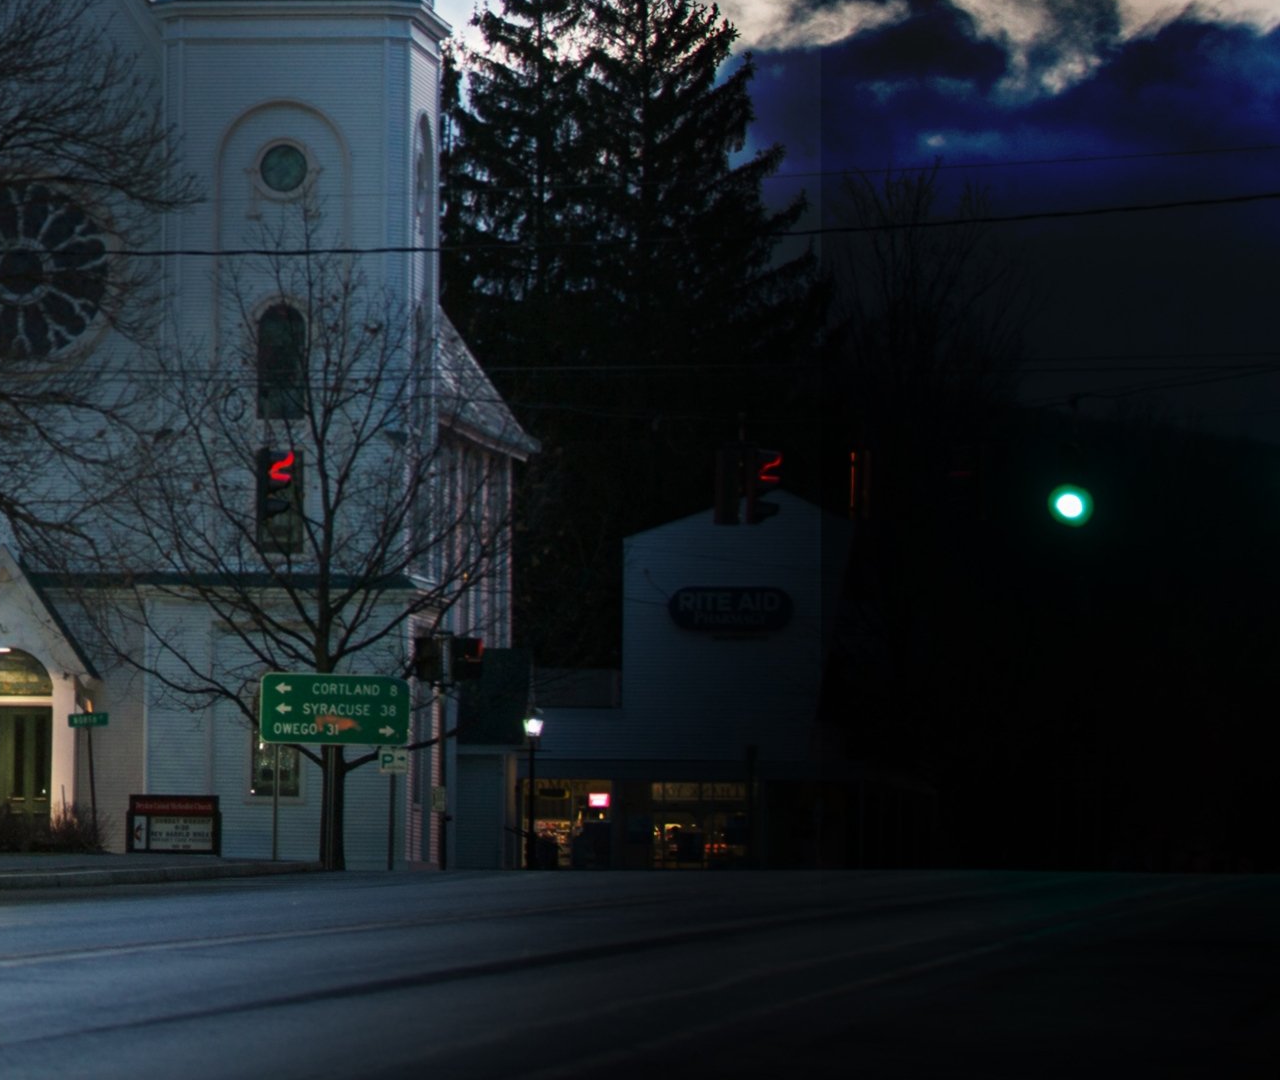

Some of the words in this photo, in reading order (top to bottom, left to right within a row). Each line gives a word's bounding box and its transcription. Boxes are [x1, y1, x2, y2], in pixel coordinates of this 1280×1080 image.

[678, 591, 731, 611] RITE
[736, 592, 782, 611] AID
[311, 682, 381, 696] CORTLAND
[389, 684, 399, 697] 8
[302, 702, 371, 716] SYRACUSE
[379, 704, 398, 717] 38
[273, 722, 318, 735] OWEGO
[325, 723, 340, 736] 31
[381, 753, 395, 769] P
